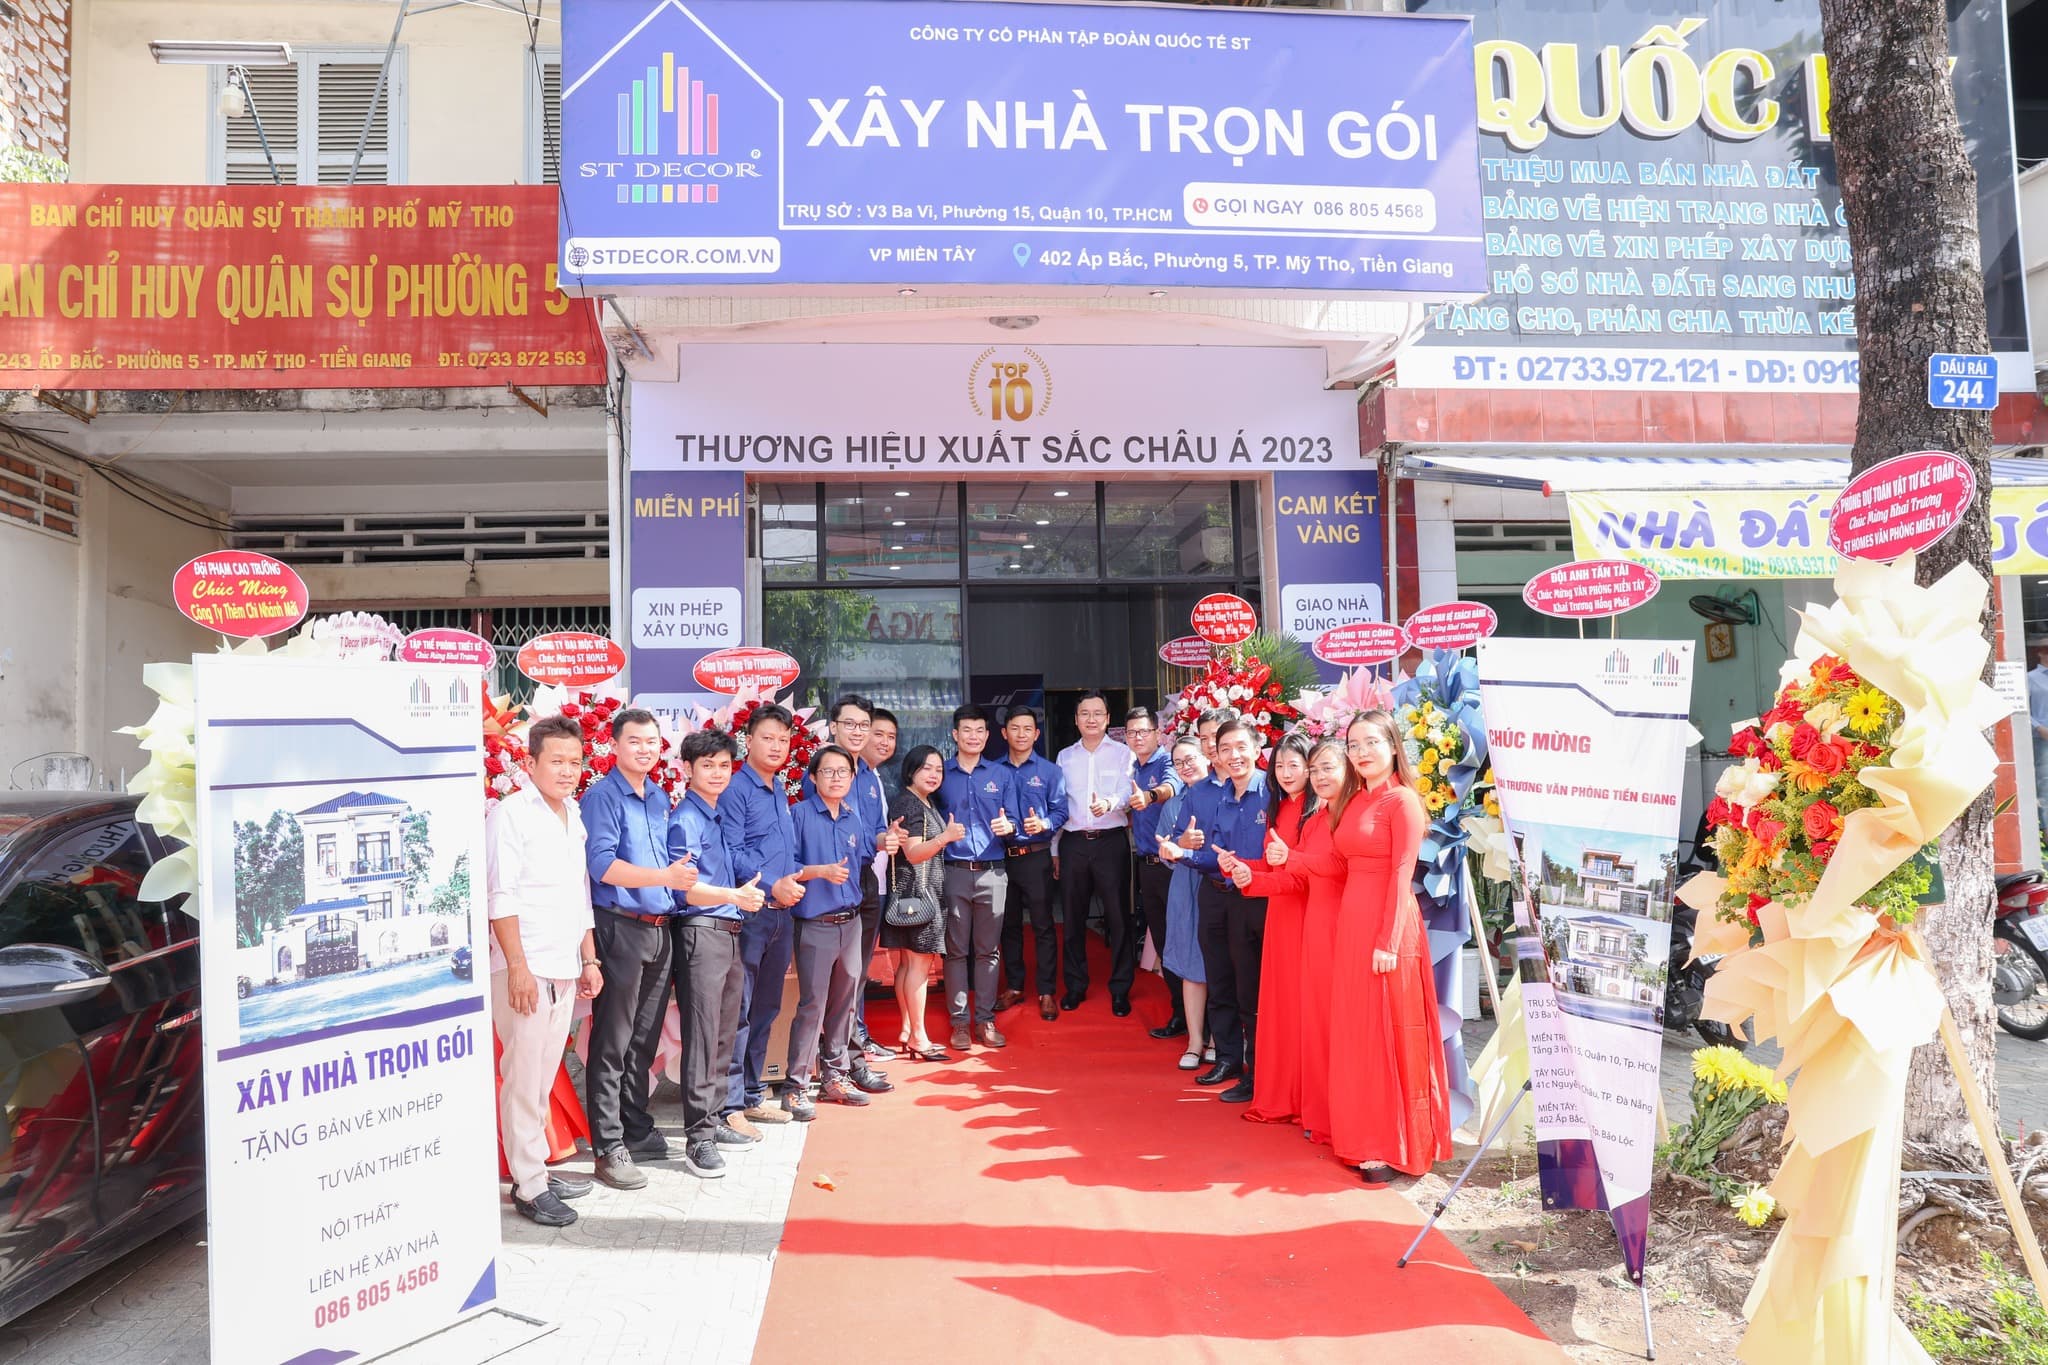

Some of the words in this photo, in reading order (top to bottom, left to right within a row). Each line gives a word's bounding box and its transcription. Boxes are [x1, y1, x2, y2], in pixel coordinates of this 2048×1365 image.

[910, 24, 959, 42] CÔNG
[963, 27, 984, 42] TY
[1067, 30, 1099, 47] TẬP
[1103, 30, 1150, 46] ĐOÀN
[1231, 36, 1252, 50] ST
[1474, 17, 1781, 150] QUỐC
[806, 85, 946, 148] XÂY
[966, 89, 1108, 151] NHÀ
[1125, 103, 1305, 167] TRỌN
[1327, 100, 1437, 161] GÓI
[579, 162, 624, 178] ST
[635, 162, 763, 178] DECOR
[1482, 155, 1563, 188] THIỆU
[1571, 160, 1632, 185] MUA
[1638, 158, 1696, 186] BÁN
[1702, 160, 1759, 188] NHÀ
[1765, 160, 1820, 190] ĐẤT
[30, 204, 77, 228] BAN
[85, 197, 123, 228] CHỈ
[131, 206, 176, 228] HUY
[184, 200, 244, 231] QUÂN
[252, 201, 285, 233] SỰ
[373, 198, 421, 228] PHỐ
[428, 200, 463, 228] MỸ
[471, 205, 513, 227] THO
[788, 205, 822, 221] TRỤ
[826, 203, 851, 219] SỞ
[866, 205, 887, 219] V3
[892, 205, 913, 219] Ba
[943, 205, 1008, 223] Phường
[1013, 207, 1035, 222] 15,
[1039, 207, 1082, 225] Quận
[1086, 207, 1108, 224] 10,
[1113, 207, 1173, 223] TP.HCM
[1214, 198, 1249, 217] GỌI
[1253, 199, 1304, 216] NGAY
[1314, 200, 1344, 217] 086
[1349, 201, 1380, 217] 805
[1384, 202, 1424, 219] 4568
[1482, 189, 1559, 221] BẢNG
[1563, 193, 1601, 221] VẼ
[1607, 195, 1669, 228] HIỆN
[1676, 201, 1768, 230] TRẠNG
[1774, 198, 1830, 227] NHÀ
[591, 248, 774, 265] STDECOR.COM.VN
[869, 248, 892, 262] VP
[942, 245, 976, 262] TÂY
[1486, 225, 1563, 257] BẢNG
[1613, 235, 1659, 260] XIN
[1665, 232, 1733, 260] PHÉP
[1741, 234, 1797, 262] XÂY
[1039, 251, 1072, 267] 402
[1108, 249, 1149, 270] Bắc,
[1153, 251, 1228, 273] Phường
[1233, 254, 1249, 272] 5,
[1254, 254, 1280, 270] TP.
[1286, 255, 1311, 275] Mỹ
[1314, 256, 1355, 275] Tho,
[1402, 259, 1454, 278] Giang
[58, 251, 118, 319] CHỈ
[131, 265, 204, 319] HUY
[216, 255, 313, 325] QUÂN
[326, 254, 378, 327] SỰ
[387, 252, 528, 317] PHƯỜNG
[1540, 267, 1579, 295] SƠ
[1585, 267, 1644, 296] NHÀ
[1722, 274, 1796, 298] SANG
[1517, 307, 1583, 336] CHO,
[1587, 304, 1662, 333] PHÂN
[1667, 309, 1733, 333] CHIA
[1738, 305, 1813, 335] THỪA
[117, 348, 183, 369] PHƯỜNG
[188, 354, 200, 369] 5
[241, 350, 267, 369] MỸ
[273, 354, 306, 369] THO
[320, 345, 357, 368] TIỀN
[362, 354, 412, 368] GIANG
[438, 353, 463, 367] ĐT:
[468, 352, 512, 367] 0733
[517, 351, 549, 367] 872
[554, 350, 586, 366] 563
[991, 362, 1030, 378] TOP
[1516, 356, 1720, 383] 02733.972.121
[1745, 358, 1796, 384] DĐ:
[988, 377, 1033, 422] 10
[1942, 379, 1984, 404] 244
[675, 433, 833, 463] THƯƠNG
[846, 430, 926, 470] HIỆU
[937, 429, 1031, 463] XUẤT
[1041, 429, 1112, 463] SẮC
[1123, 429, 1217, 463] CHÂU
[1228, 429, 1252, 463] Á
[1261, 435, 1333, 463] 2023
[1932, 460, 1955, 484] TOÁN
[634, 492, 693, 518] MIỄN
[701, 491, 740, 518] PHÍ
[1278, 495, 1327, 515] CAM
[1334, 491, 1377, 515] KẾT
[1296, 519, 1361, 544] VÀNG
[1596, 500, 1716, 549] NHÀ
[208, 562, 232, 578] PHẠM
[233, 562, 250, 575] CAO
[1569, 569, 1589, 581] ANH
[192, 579, 235, 599] Chúc
[239, 579, 288, 599] Mừng
[648, 602, 675, 616] XIN
[680, 599, 723, 616] PHÉP
[1296, 598, 1333, 612] GIAO
[1337, 594, 1369, 611] NHÀ
[642, 619, 676, 637] XÂY
[680, 622, 729, 640] DỰNG
[1488, 727, 1525, 749] CHÚC
[1532, 730, 1591, 753] MỪNG
[1546, 783, 1568, 796] VĂN
[1571, 785, 1609, 799] PHÒNG
[1641, 792, 1676, 806] GIANG
[236, 1068, 292, 1113] XÂY
[302, 1050, 358, 1097] NHÀ
[364, 1039, 428, 1080] TRỌN
[436, 1024, 474, 1064] GÓI
[1637, 1061, 1657, 1074] HCM
[241, 1123, 308, 1162] TẶNG
[317, 1116, 351, 1141] BẢN
[354, 1109, 374, 1130] VẼ
[378, 1103, 403, 1125] XIN
[407, 1092, 443, 1117] PHÉP
[1538, 1115, 1553, 1123] 402
[318, 1169, 341, 1191] TƯ
[343, 1159, 376, 1183] VẤN
[379, 1144, 421, 1172] THIẾT
[321, 1217, 350, 1242] NỘI
[309, 1267, 345, 1294] LIÊN
[349, 1254, 370, 1278] HỆ
[374, 1245, 403, 1269] XÂY
[407, 1230, 440, 1257] NHÀ
[314, 1295, 350, 1329] 086
[356, 1279, 390, 1312] 805
[396, 1260, 439, 1294] 4568
